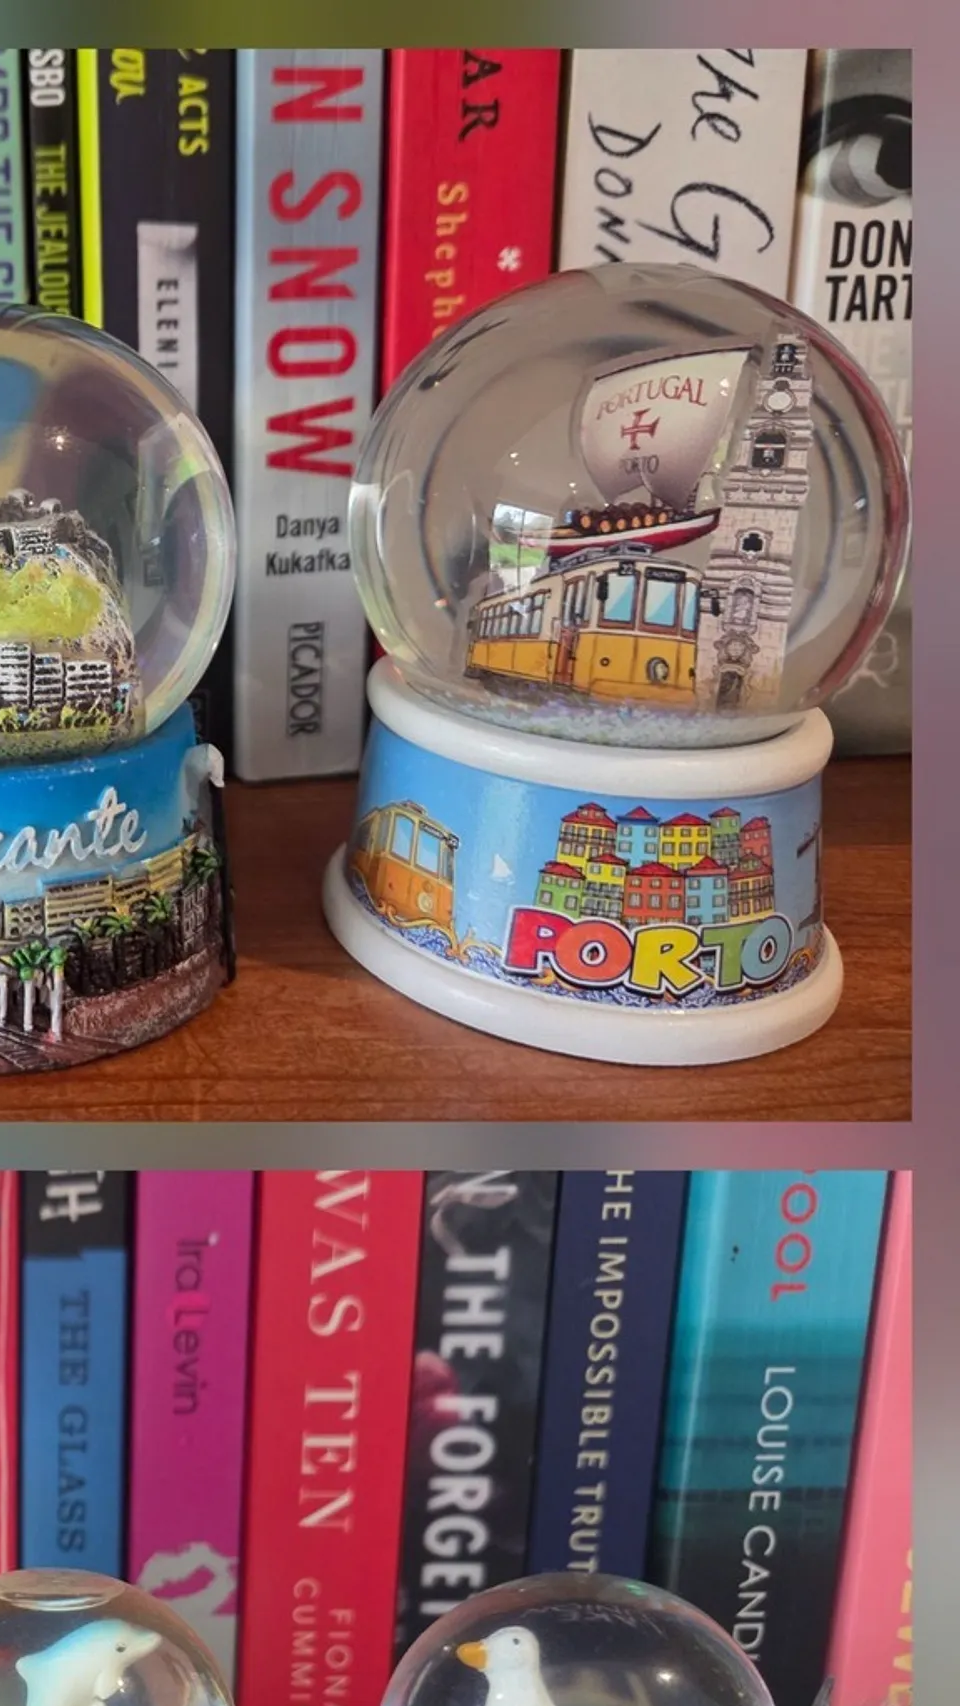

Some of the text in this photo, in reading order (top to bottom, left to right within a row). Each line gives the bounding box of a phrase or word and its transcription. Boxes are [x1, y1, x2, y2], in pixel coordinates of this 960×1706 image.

[34, 143, 69, 197] THE
[177, 75, 211, 157] ACTS
[156, 278, 179, 369] ELENI
[265, 169, 364, 478] SNOW
[596, 375, 707, 420] PORTUGAL
[265, 550, 352, 577] Kukafka
[276, 514, 340, 539] Danya
[288, 621, 323, 736] PICADOR
[503, 906, 794, 996] PORTO
[171, 1231, 220, 1417] Ira Levin
[439, 1246, 513, 1362] THE
[572, 1236, 630, 1471] IMPOSSIBLE
[56, 1289, 90, 1556] THE GLASS
[297, 1368, 362, 1535] TEN
[748, 1366, 798, 1513] LOUISE
